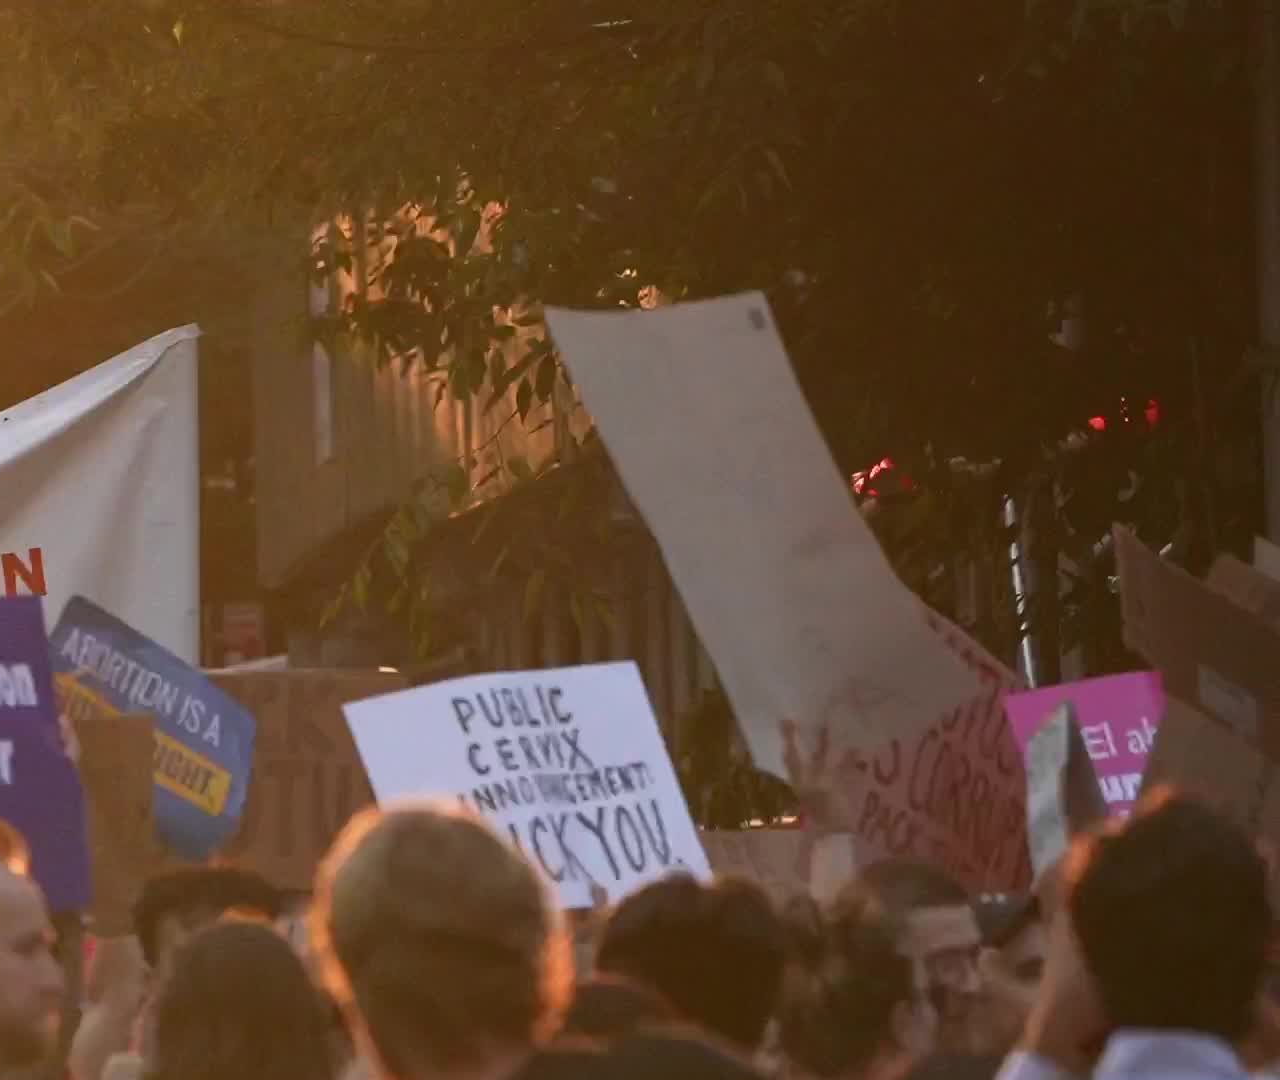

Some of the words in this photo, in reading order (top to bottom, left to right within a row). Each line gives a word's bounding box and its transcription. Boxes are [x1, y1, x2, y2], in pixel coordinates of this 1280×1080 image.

[59, 627, 179, 716] ABORTION
[176, 691, 207, 733] IS
[202, 713, 220, 748] A
[451, 685, 572, 734] PUBLIC
[466, 727, 594, 776] CERVIX
[1079, 721, 1117, 761] El
